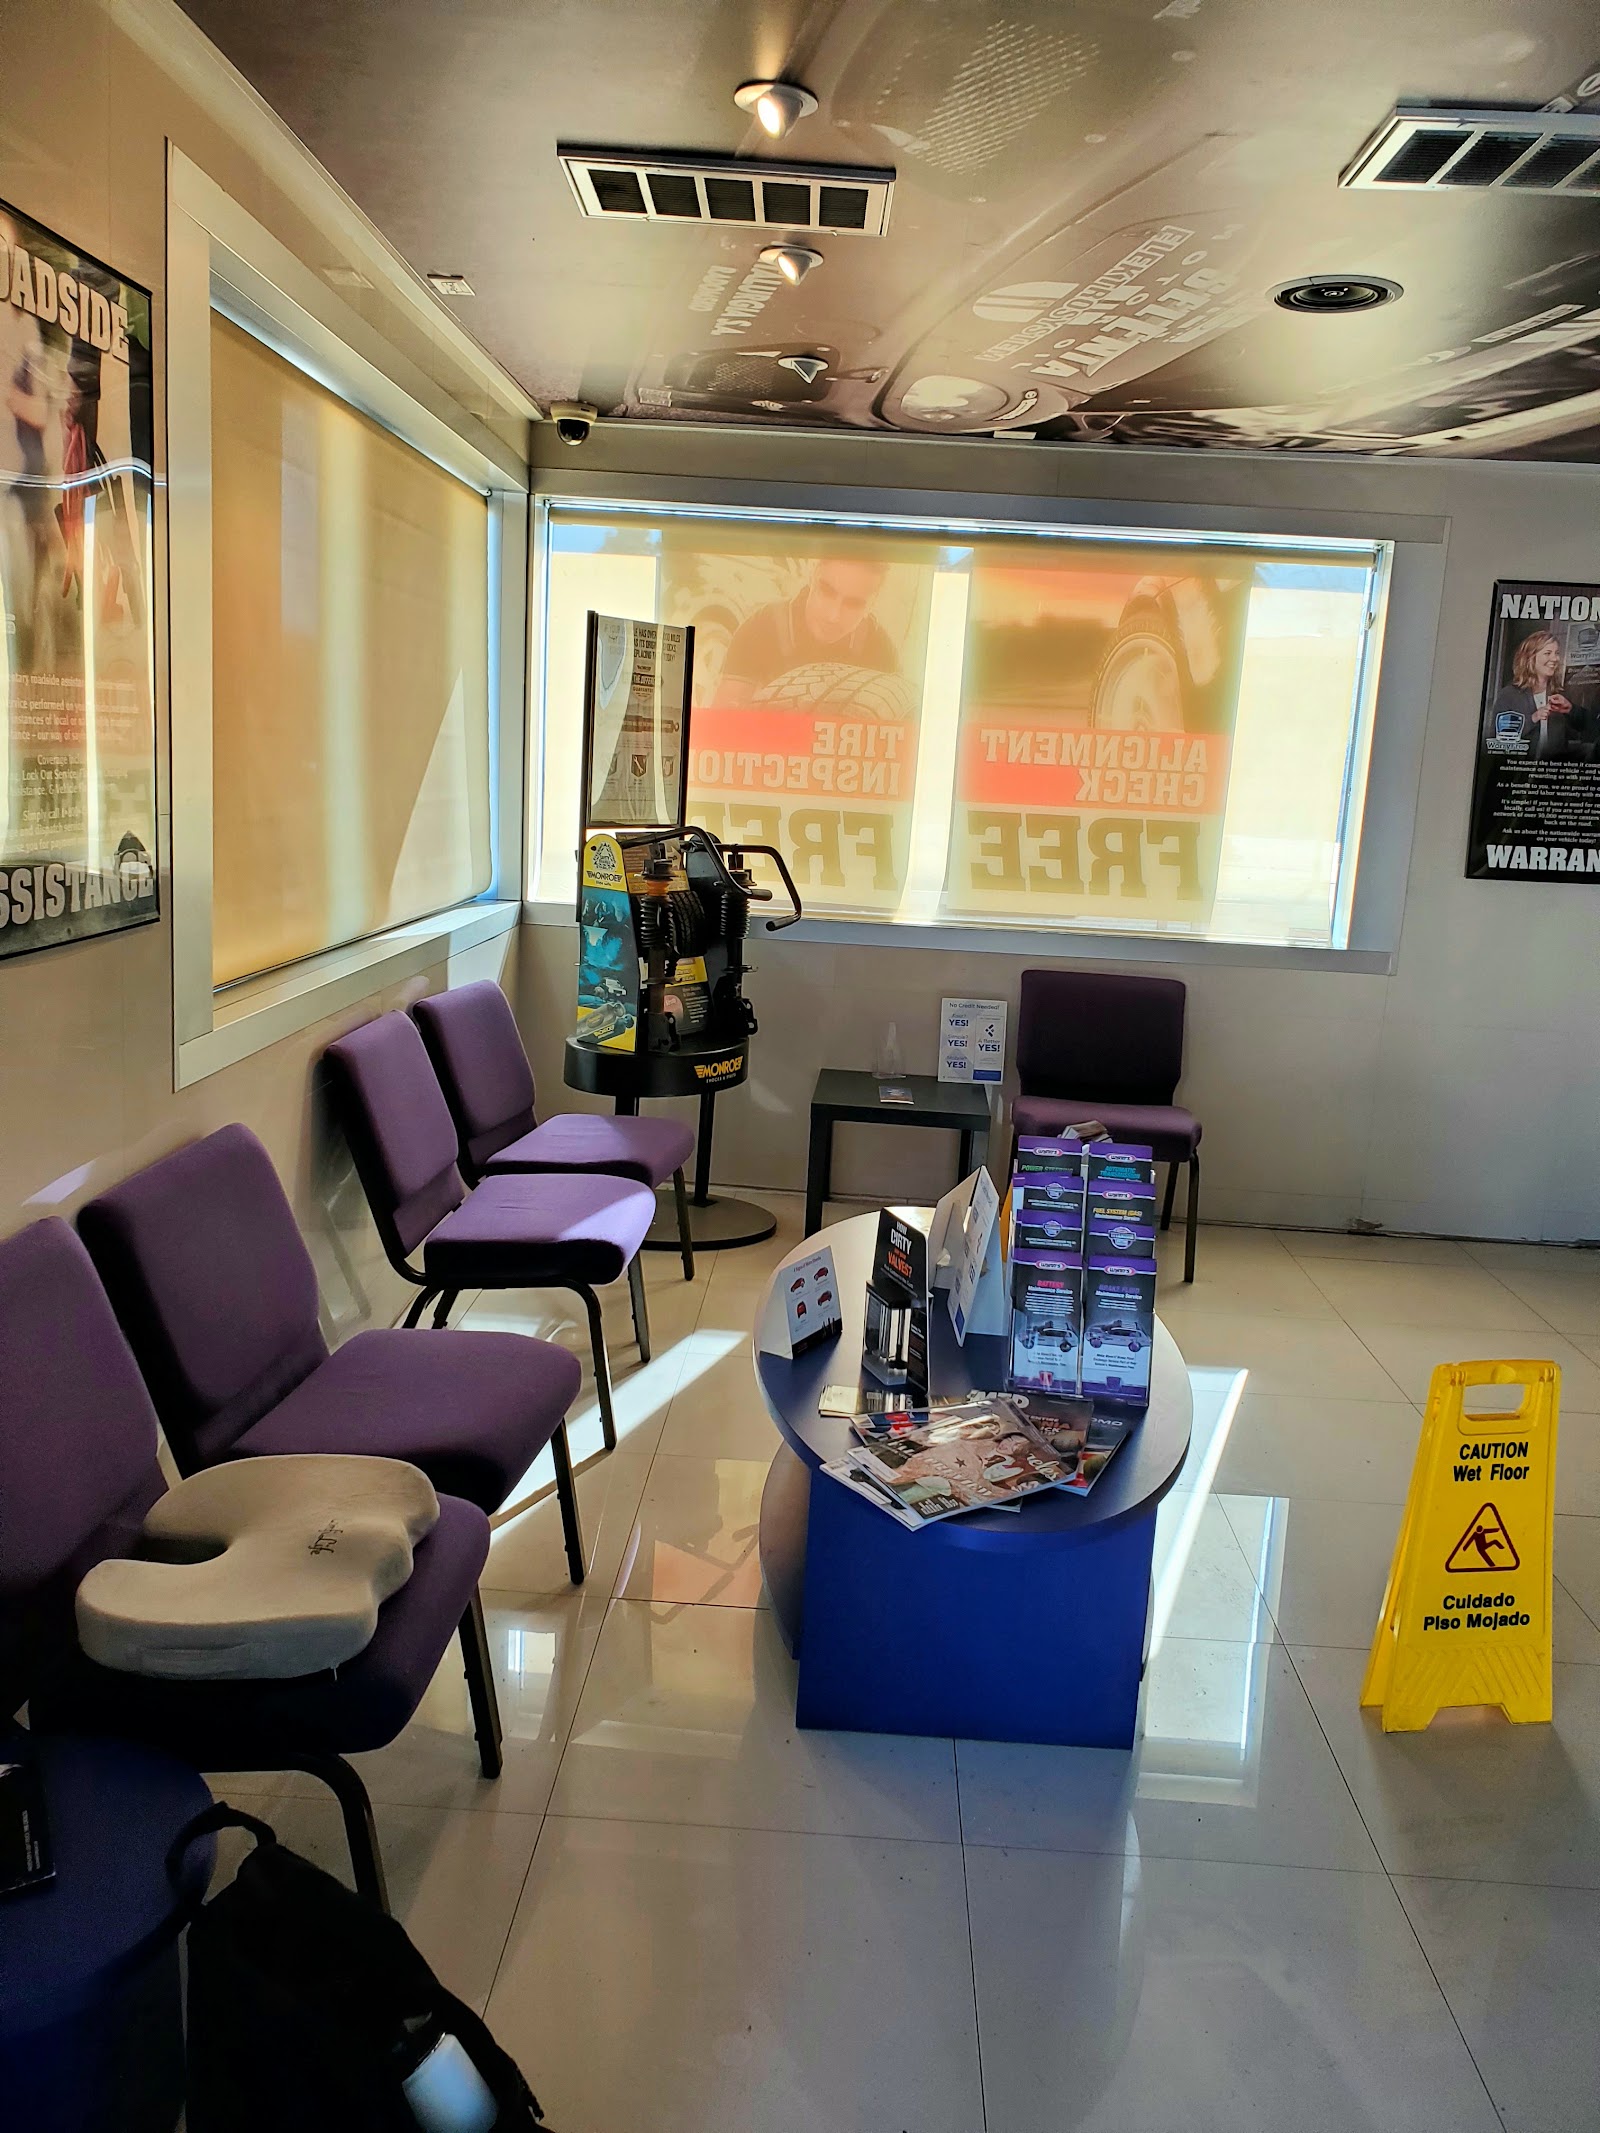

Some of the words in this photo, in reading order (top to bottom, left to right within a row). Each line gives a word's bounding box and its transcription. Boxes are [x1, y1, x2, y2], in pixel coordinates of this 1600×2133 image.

[588, 870, 622, 883] MONROE
[949, 1019, 969, 1027] YES!
[947, 1039, 967, 1047] YES!
[978, 1044, 1000, 1052] YES!
[694, 1056, 743, 1078] MONROE
[946, 1061, 966, 1069] YES!
[1107, 1208, 1127, 1216] SYSTEM
[896, 1221, 908, 1236] HOW
[890, 1228, 912, 1256] DIRTY
[1037, 1280, 1064, 1288] BATTERY
[1459, 1441, 1529, 1460] CAUTION
[1453, 1465, 1482, 1482] Wet
[1490, 1463, 1530, 1481] Floor
[1442, 1592, 1515, 1610] Cuidado
[1423, 1615, 1460, 1631] Piso
[1466, 1612, 1530, 1632] Mojado
